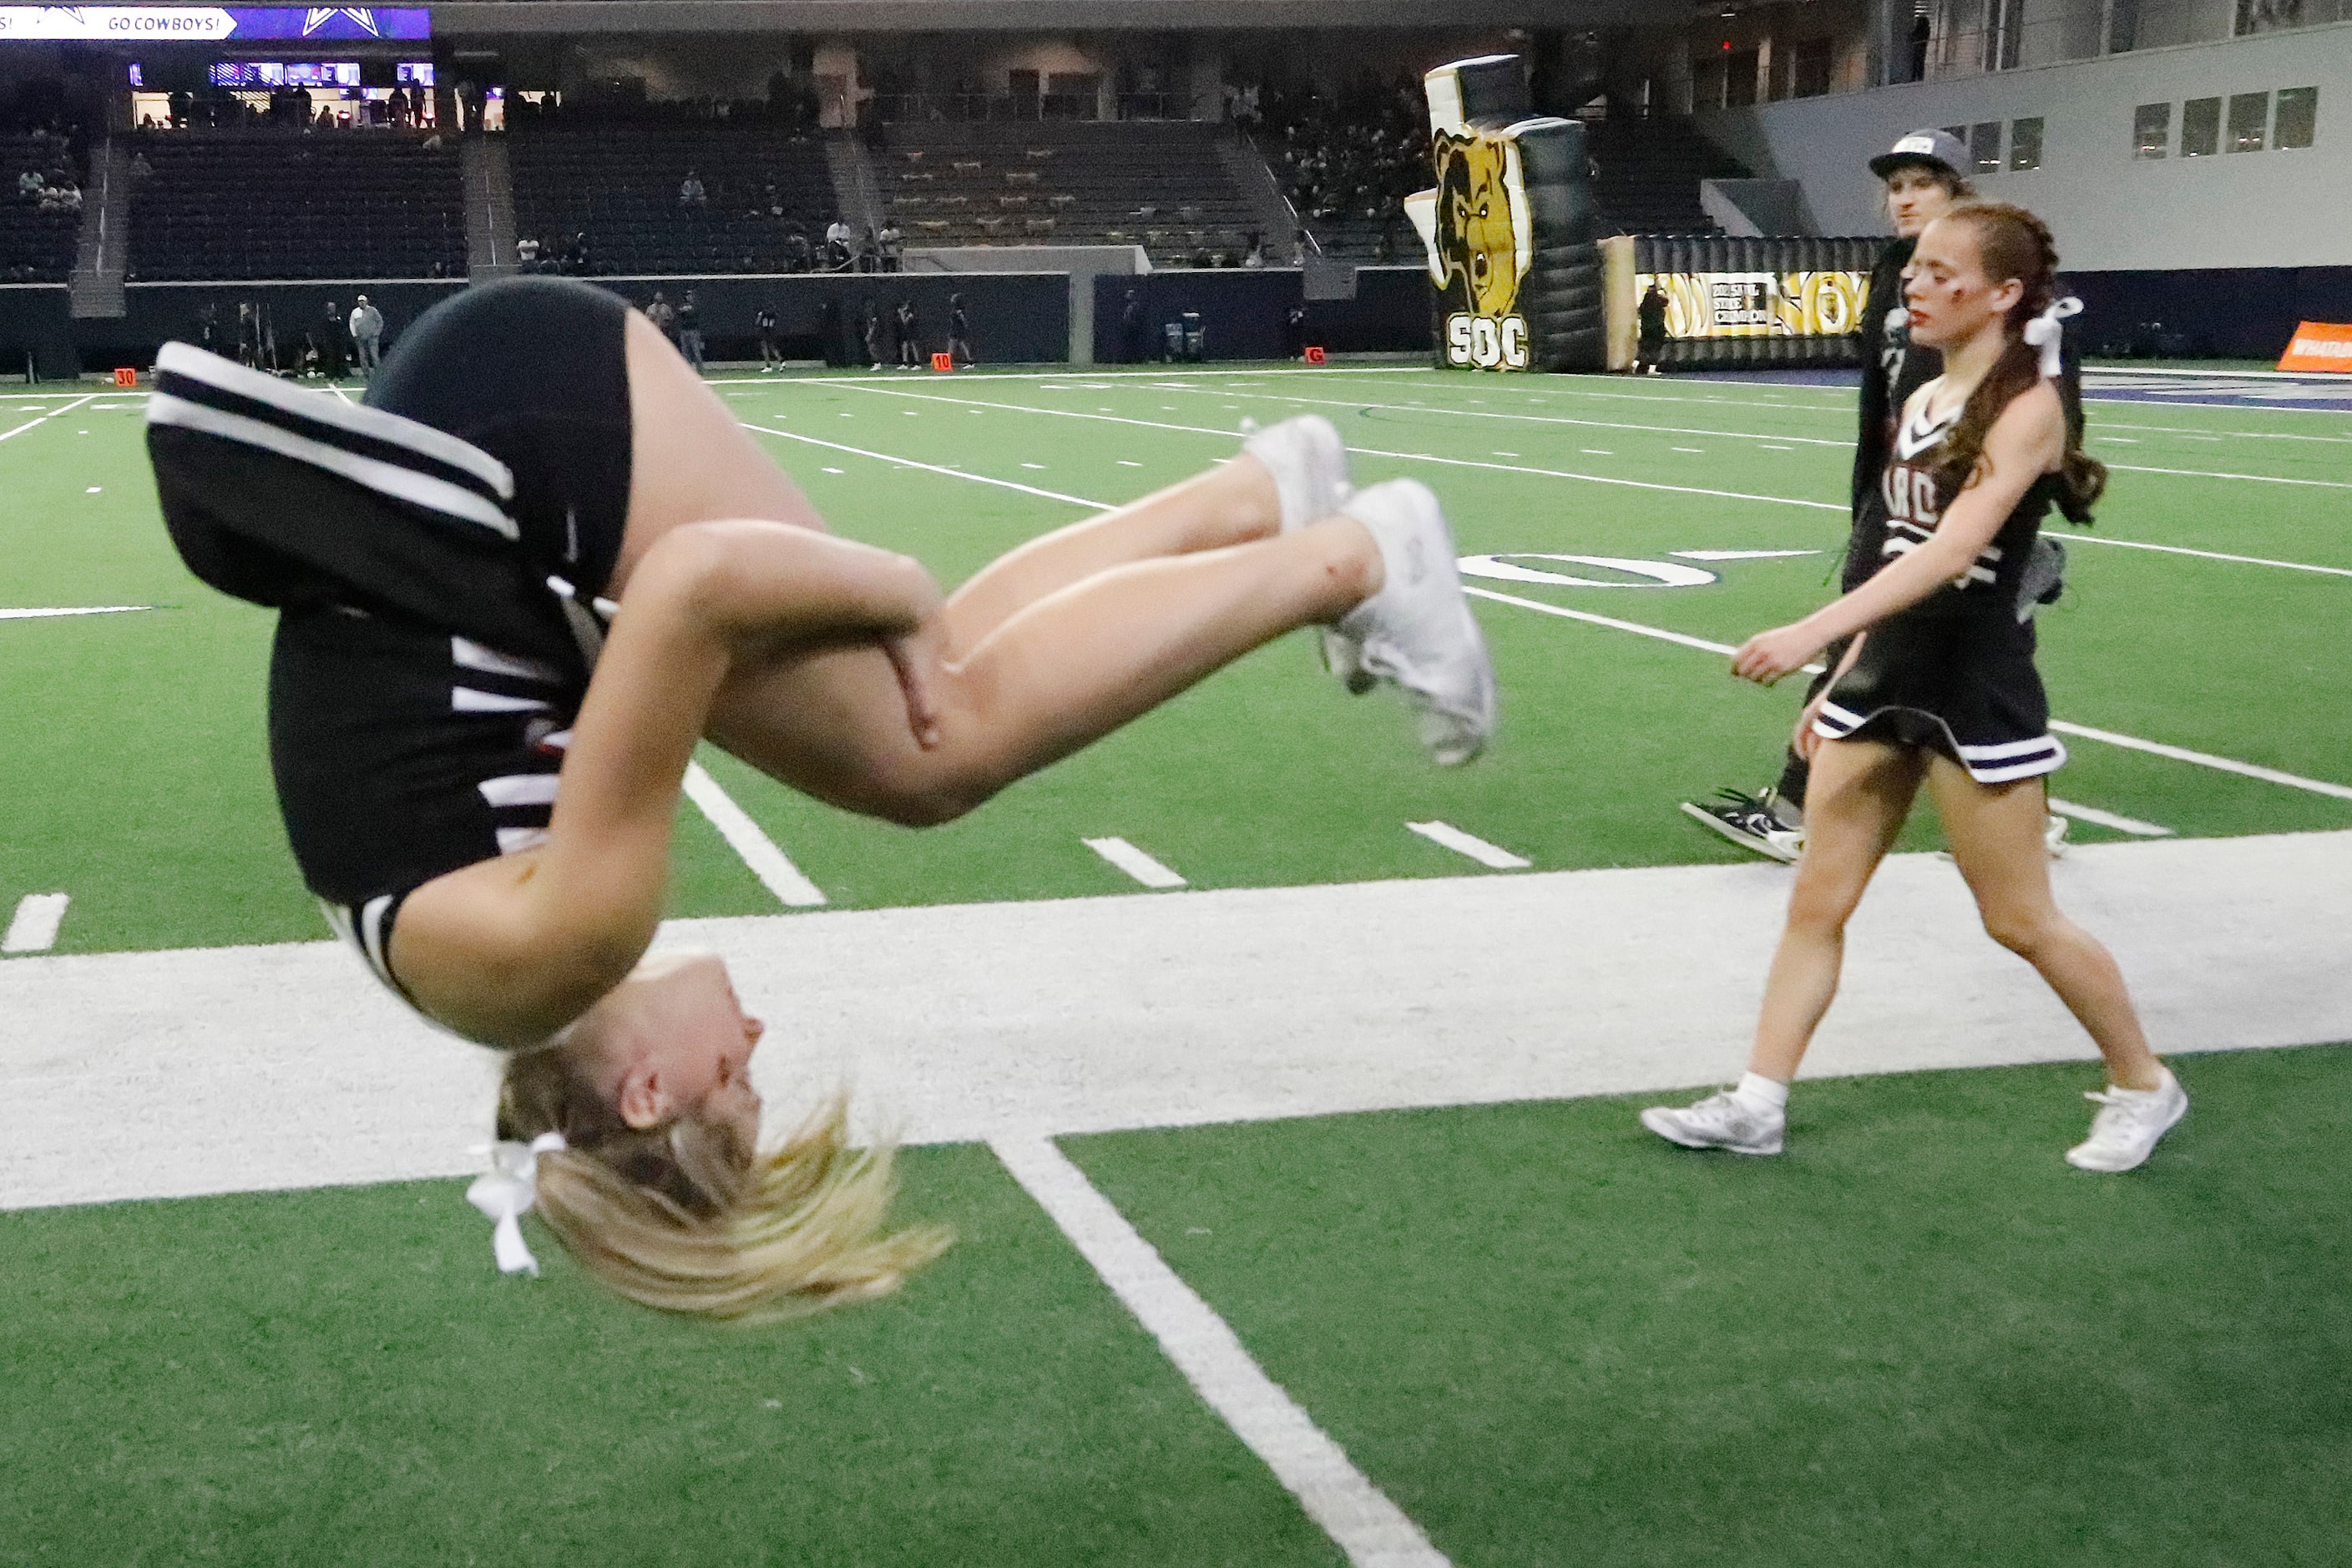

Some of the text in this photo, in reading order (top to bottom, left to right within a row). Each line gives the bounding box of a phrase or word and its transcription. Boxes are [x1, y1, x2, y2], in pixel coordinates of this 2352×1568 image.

[109, 18, 220, 30] GO COWBOYS!
[1448, 314, 1527, 368] SOC
[936, 355, 949, 368] 10
[1310, 348, 1324, 362] G
[118, 371, 134, 385] 30
